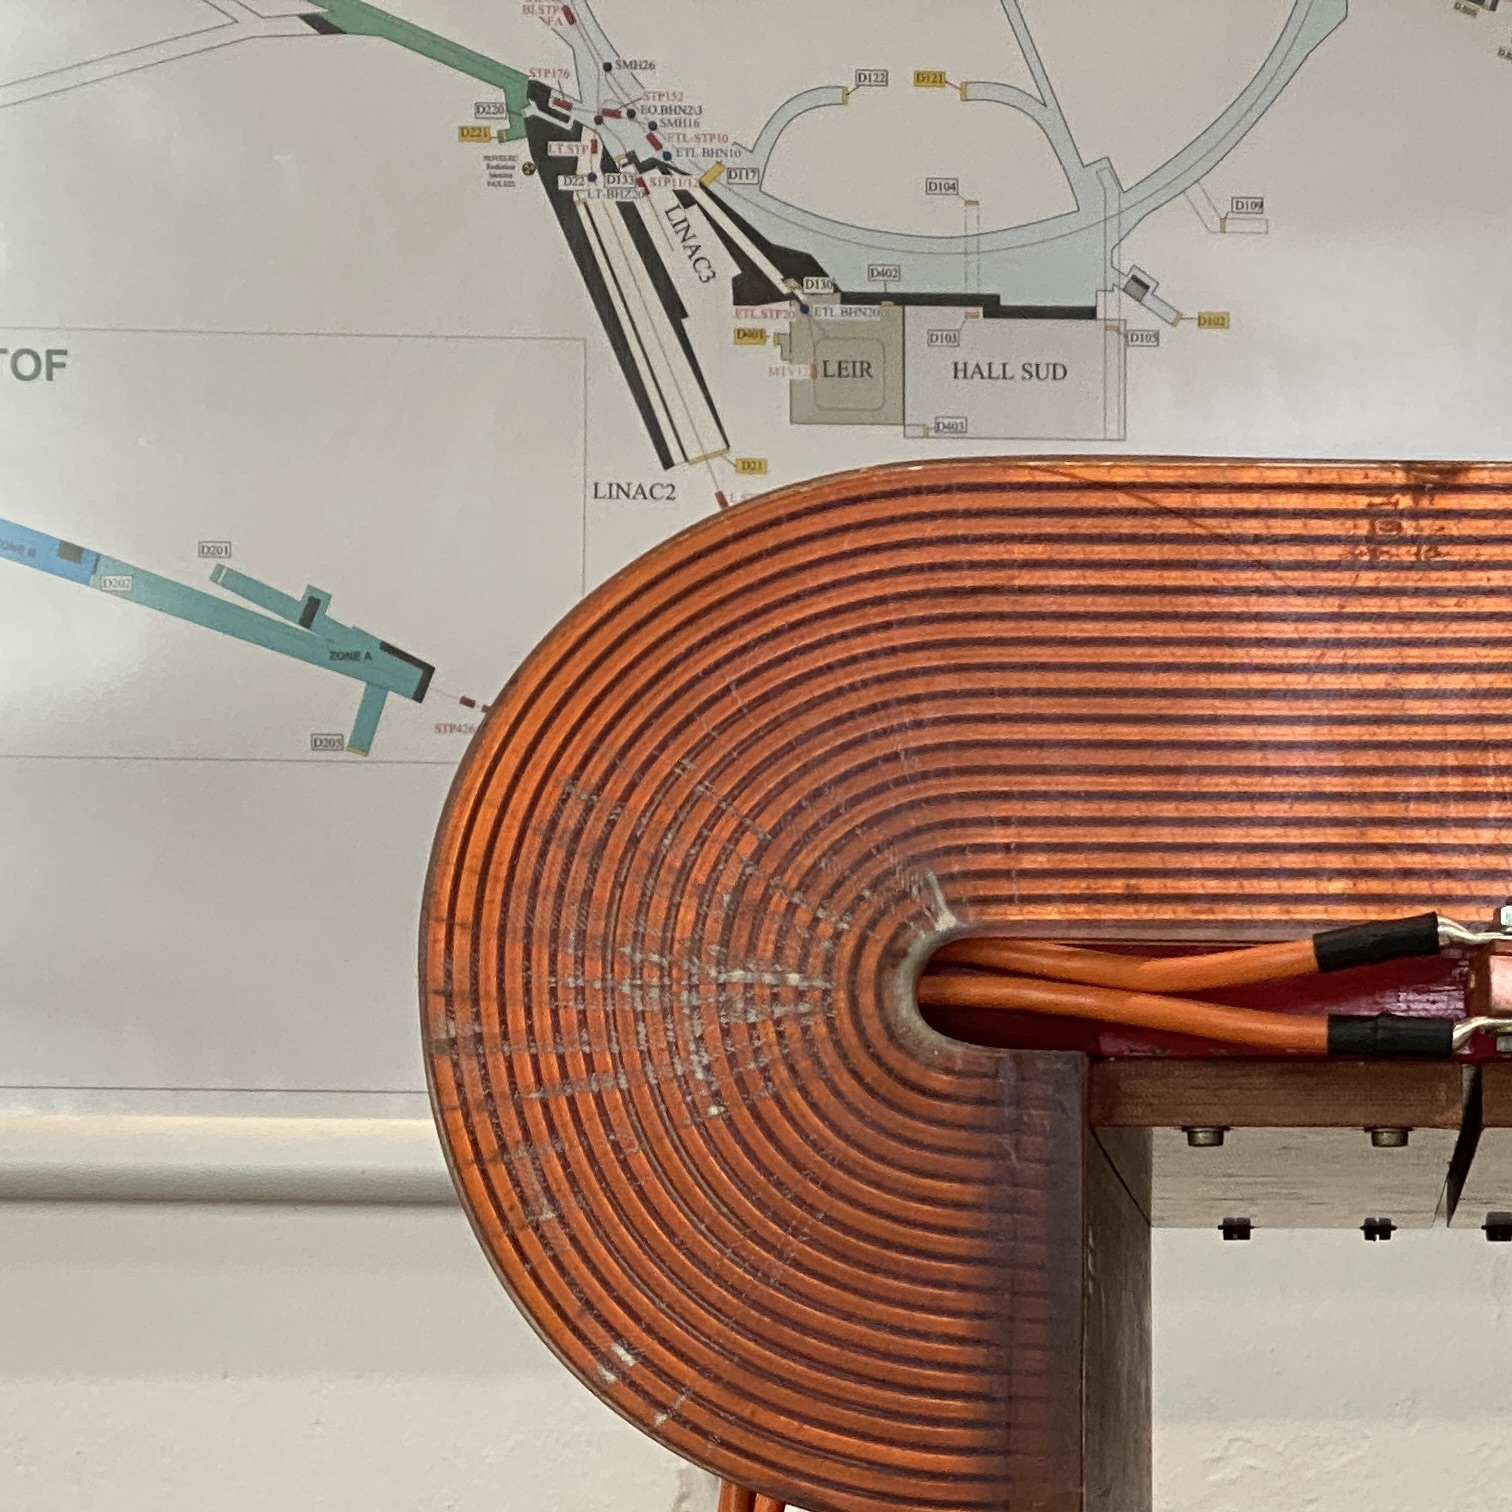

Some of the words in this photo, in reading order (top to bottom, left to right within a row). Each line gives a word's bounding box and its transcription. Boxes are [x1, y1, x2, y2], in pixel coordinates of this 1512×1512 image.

[614, 60, 656, 71] SMH26
[857, 72, 886, 84] D122
[606, 174, 635, 185] D133
[728, 169, 758, 180] D117
[563, 176, 586, 186] D22
[928, 180, 957, 192] D104
[664, 205, 716, 284] LINAC3
[869, 268, 899, 278] D402
[805, 279, 833, 289] D130
[1198, 315, 1227, 327] D102
[929, 332, 957, 344] D103
[1130, 332, 1158, 344] D105
[821, 360, 874, 379] LEIR
[952, 361, 1015, 381] HALL
[1021, 362, 1068, 382] SUD
[936, 420, 966, 432] D403
[741, 461, 763, 471] D21
[593, 481, 677, 500] LINAC2
[201, 544, 229, 556] D201
[103, 578, 131, 589] D202
[329, 651, 361, 662] ZONE
[362, 651, 374, 661] A
[313, 738, 343, 749] D205
